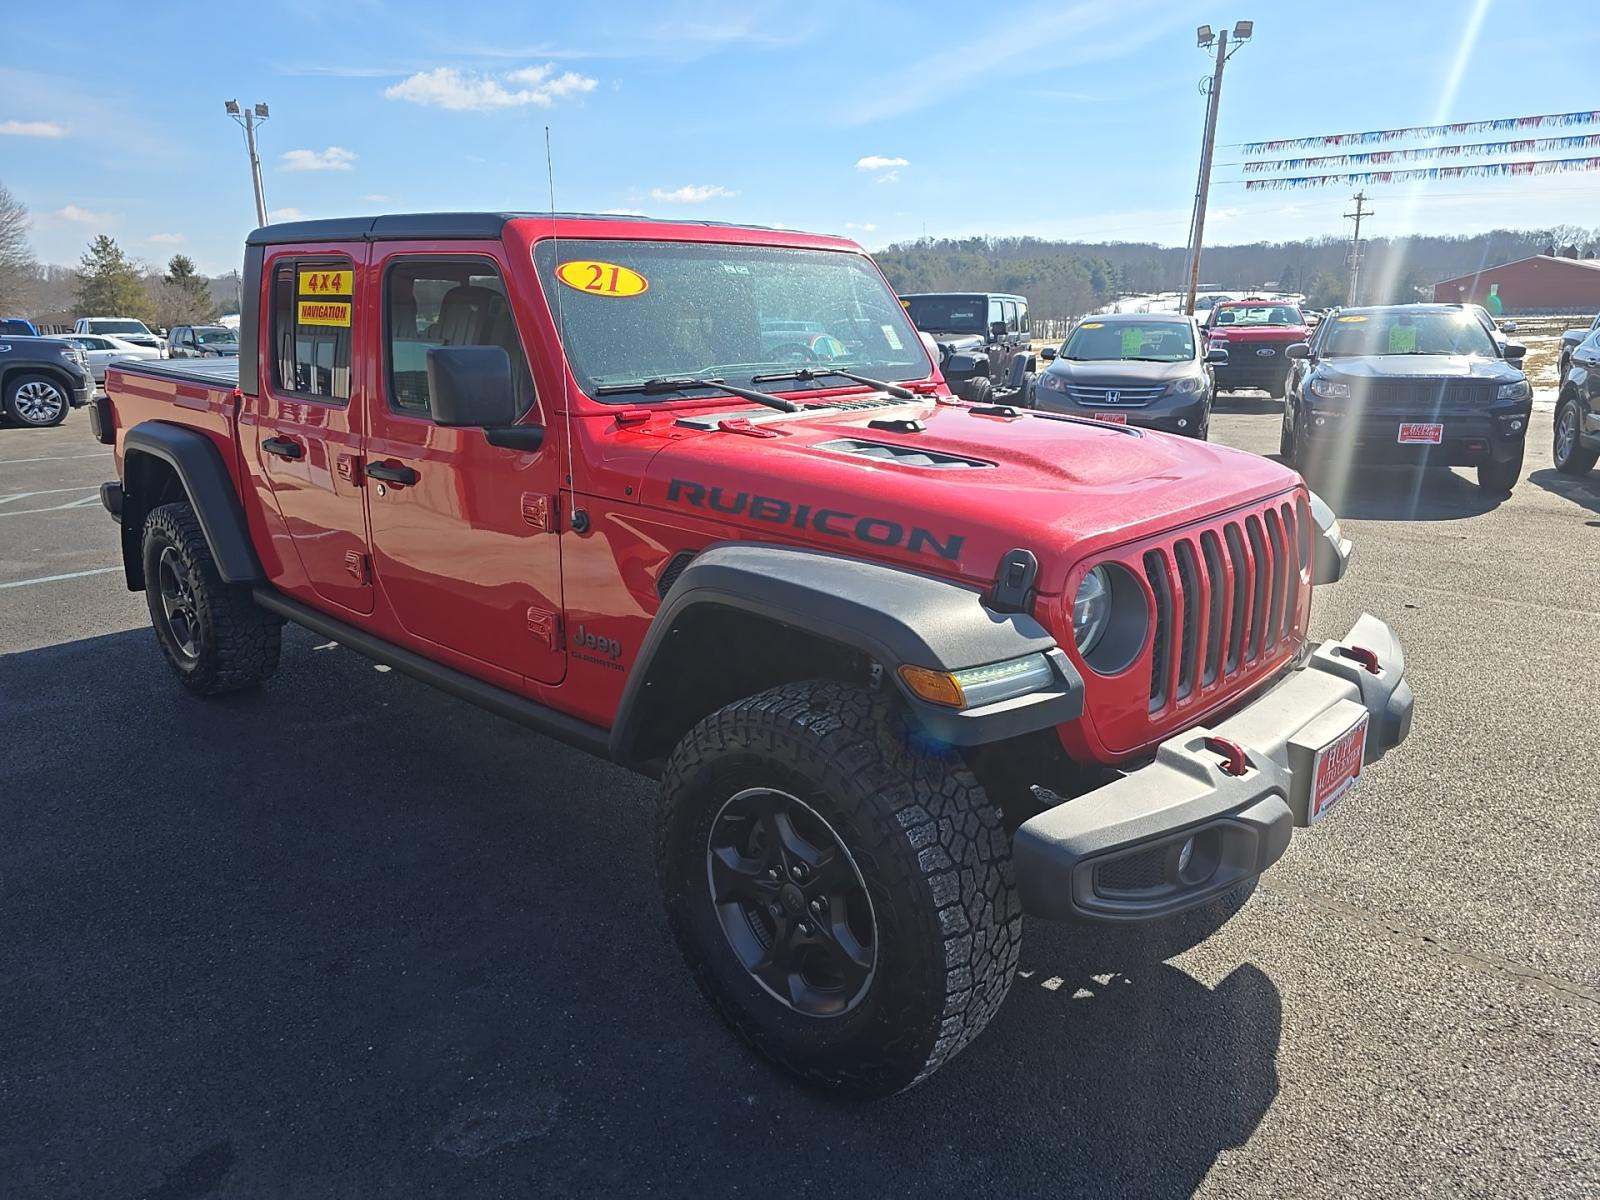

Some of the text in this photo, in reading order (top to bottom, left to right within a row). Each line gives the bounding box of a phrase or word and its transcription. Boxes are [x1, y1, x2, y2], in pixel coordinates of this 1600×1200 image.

[584, 264, 620, 293] 21
[302, 305, 347, 320] NAVIGATION
[666, 479, 966, 561] RUBICON
[573, 624, 622, 660] Jeep
